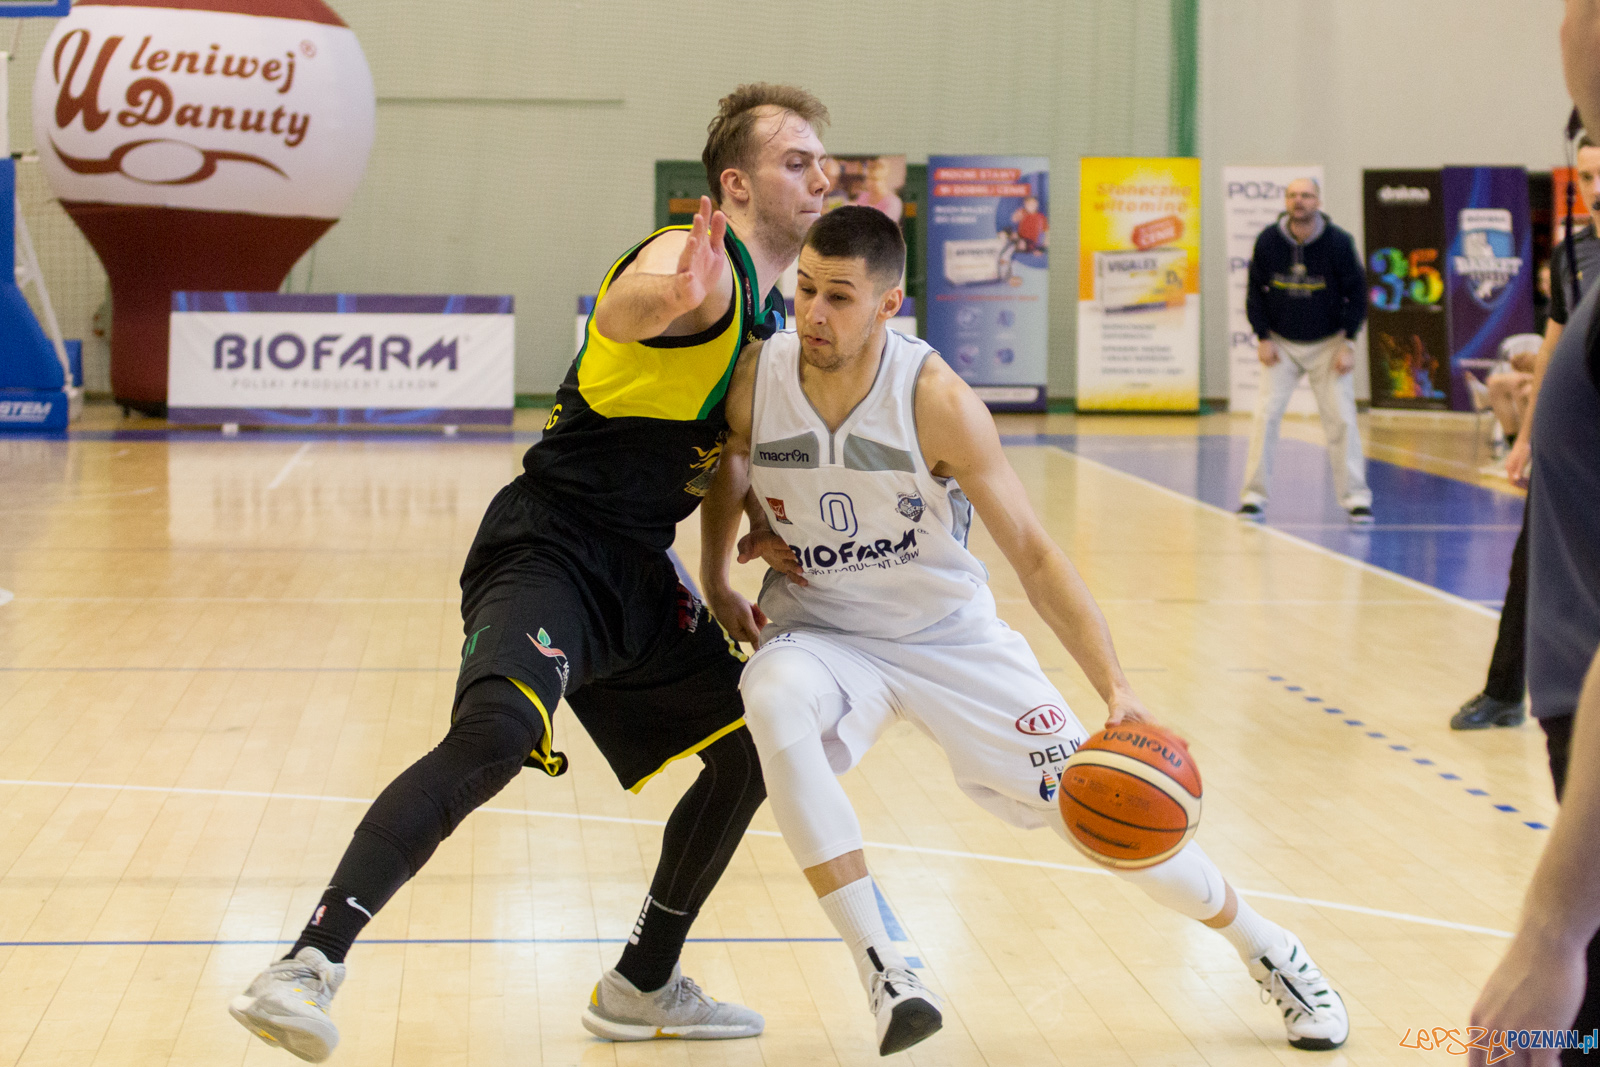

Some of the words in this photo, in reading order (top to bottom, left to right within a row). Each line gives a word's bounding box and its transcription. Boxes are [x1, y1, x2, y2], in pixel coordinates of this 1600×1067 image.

[53, 29, 124, 131] U
[130, 36, 296, 94] leniwej
[117, 77, 311, 147] Danuty
[1368, 248, 1444, 311] 35
[213, 332, 459, 372] BIOFARM
[759, 449, 810, 463] macron
[819, 491, 859, 538] 0
[1103, 731, 1182, 768] molten
